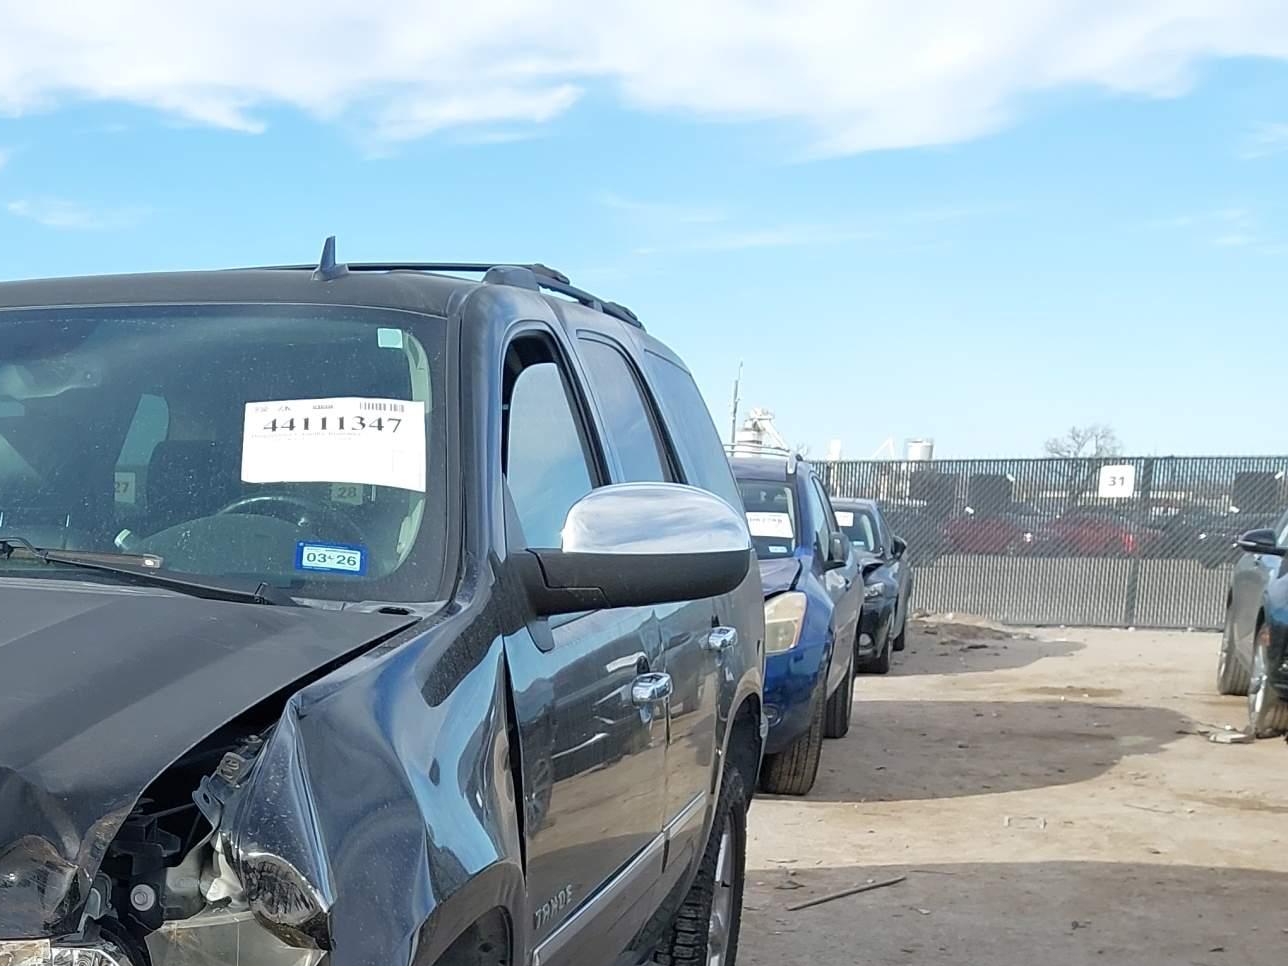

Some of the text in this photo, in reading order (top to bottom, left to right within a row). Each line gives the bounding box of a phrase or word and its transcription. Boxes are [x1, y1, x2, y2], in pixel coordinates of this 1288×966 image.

[263, 415, 402, 433] 44111347
[114, 481, 130, 493] 27
[1107, 476, 1125, 487] 31
[337, 486, 357, 498] 28
[535, 884, 572, 929] TAHOE
